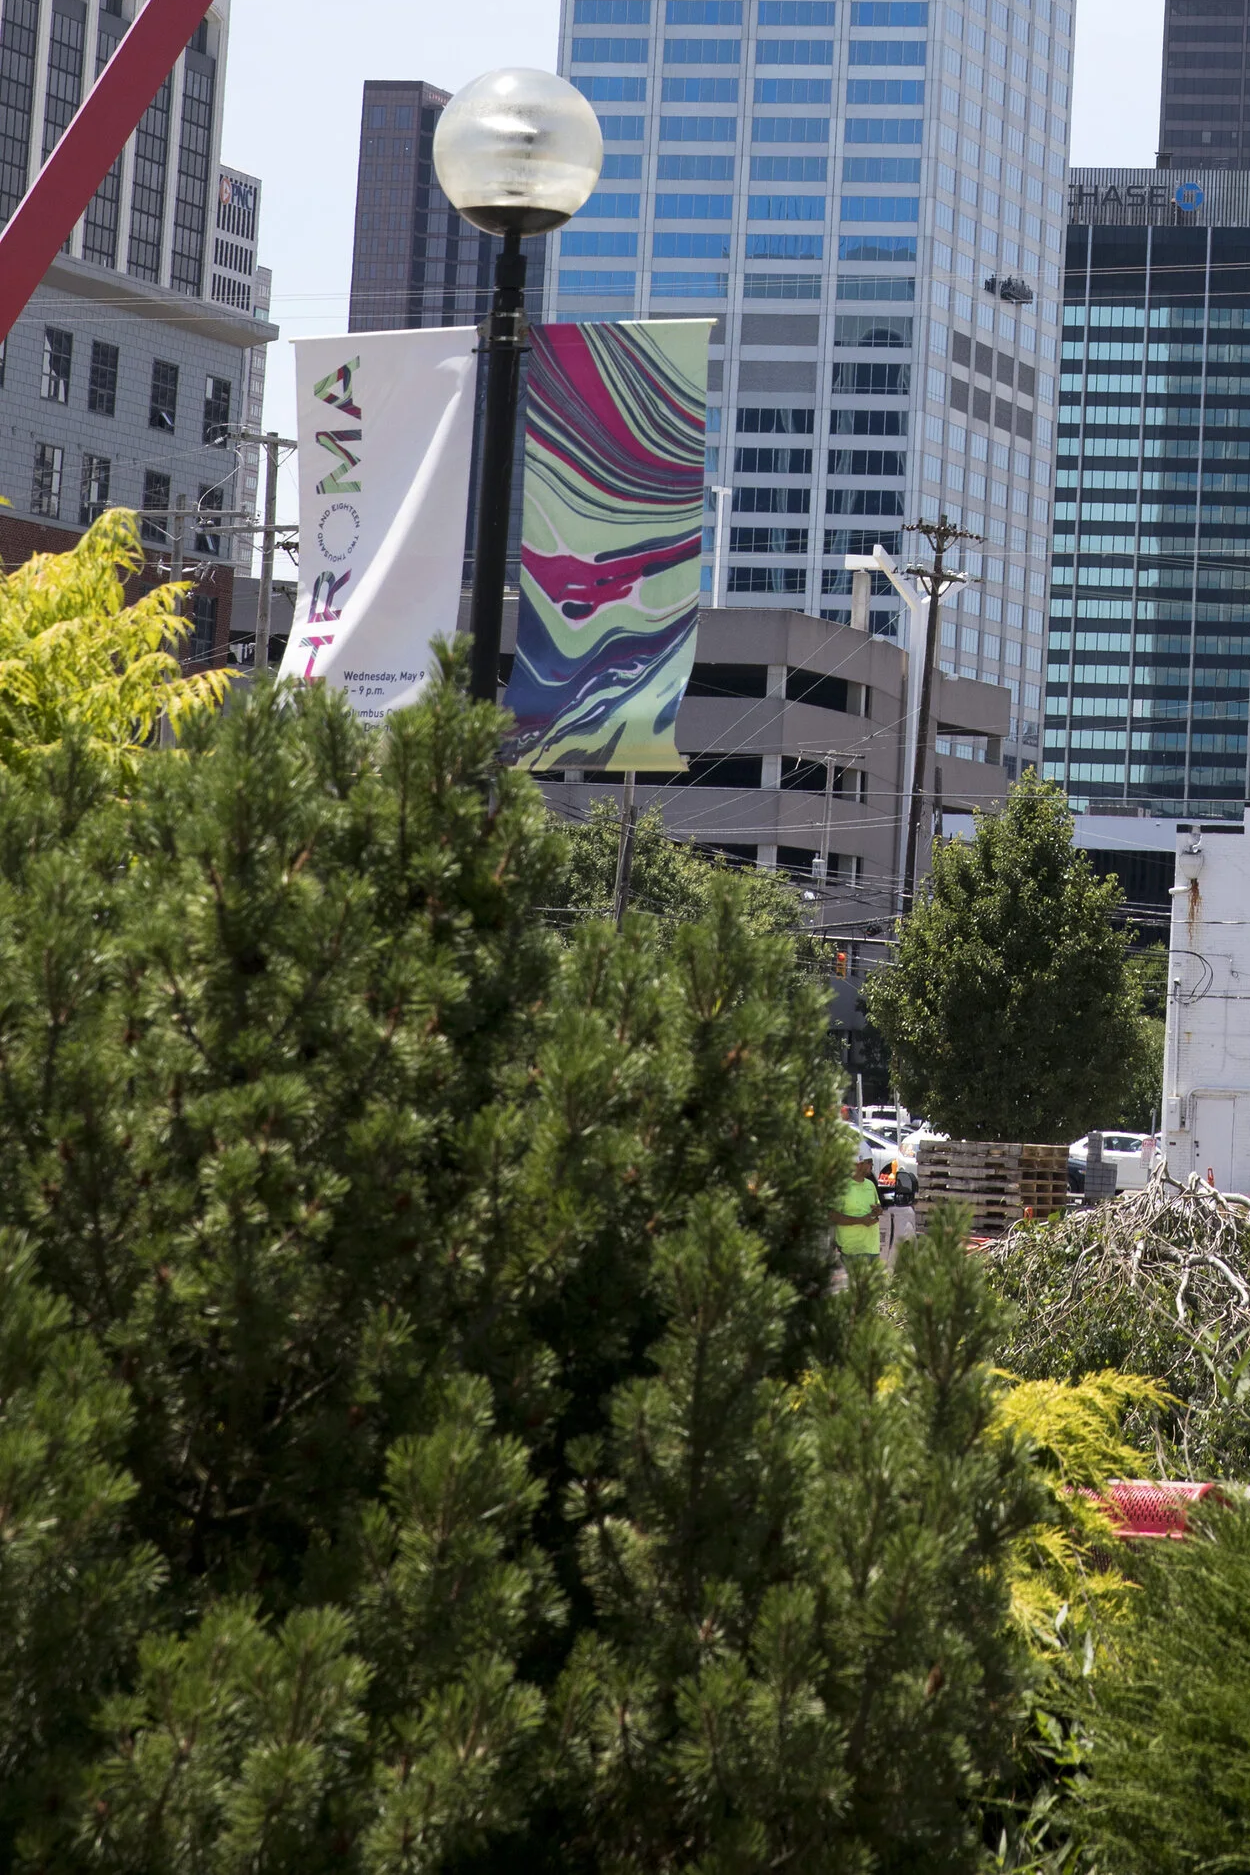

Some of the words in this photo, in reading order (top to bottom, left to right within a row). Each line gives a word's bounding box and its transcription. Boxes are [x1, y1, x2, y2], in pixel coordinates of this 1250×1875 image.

[231, 183, 253, 211] PNC
[318, 509, 331, 530] AND
[331, 502, 360, 528] EIGHTEEN
[317, 532, 346, 562] THOUSAND
[347, 535, 360, 554] TWO
[343, 670, 398, 683] Wednesday,
[399, 671, 418, 683] May
[418, 671, 425, 681] 9
[359, 685, 365, 695] 9
[366, 687, 385, 698] p.m.
